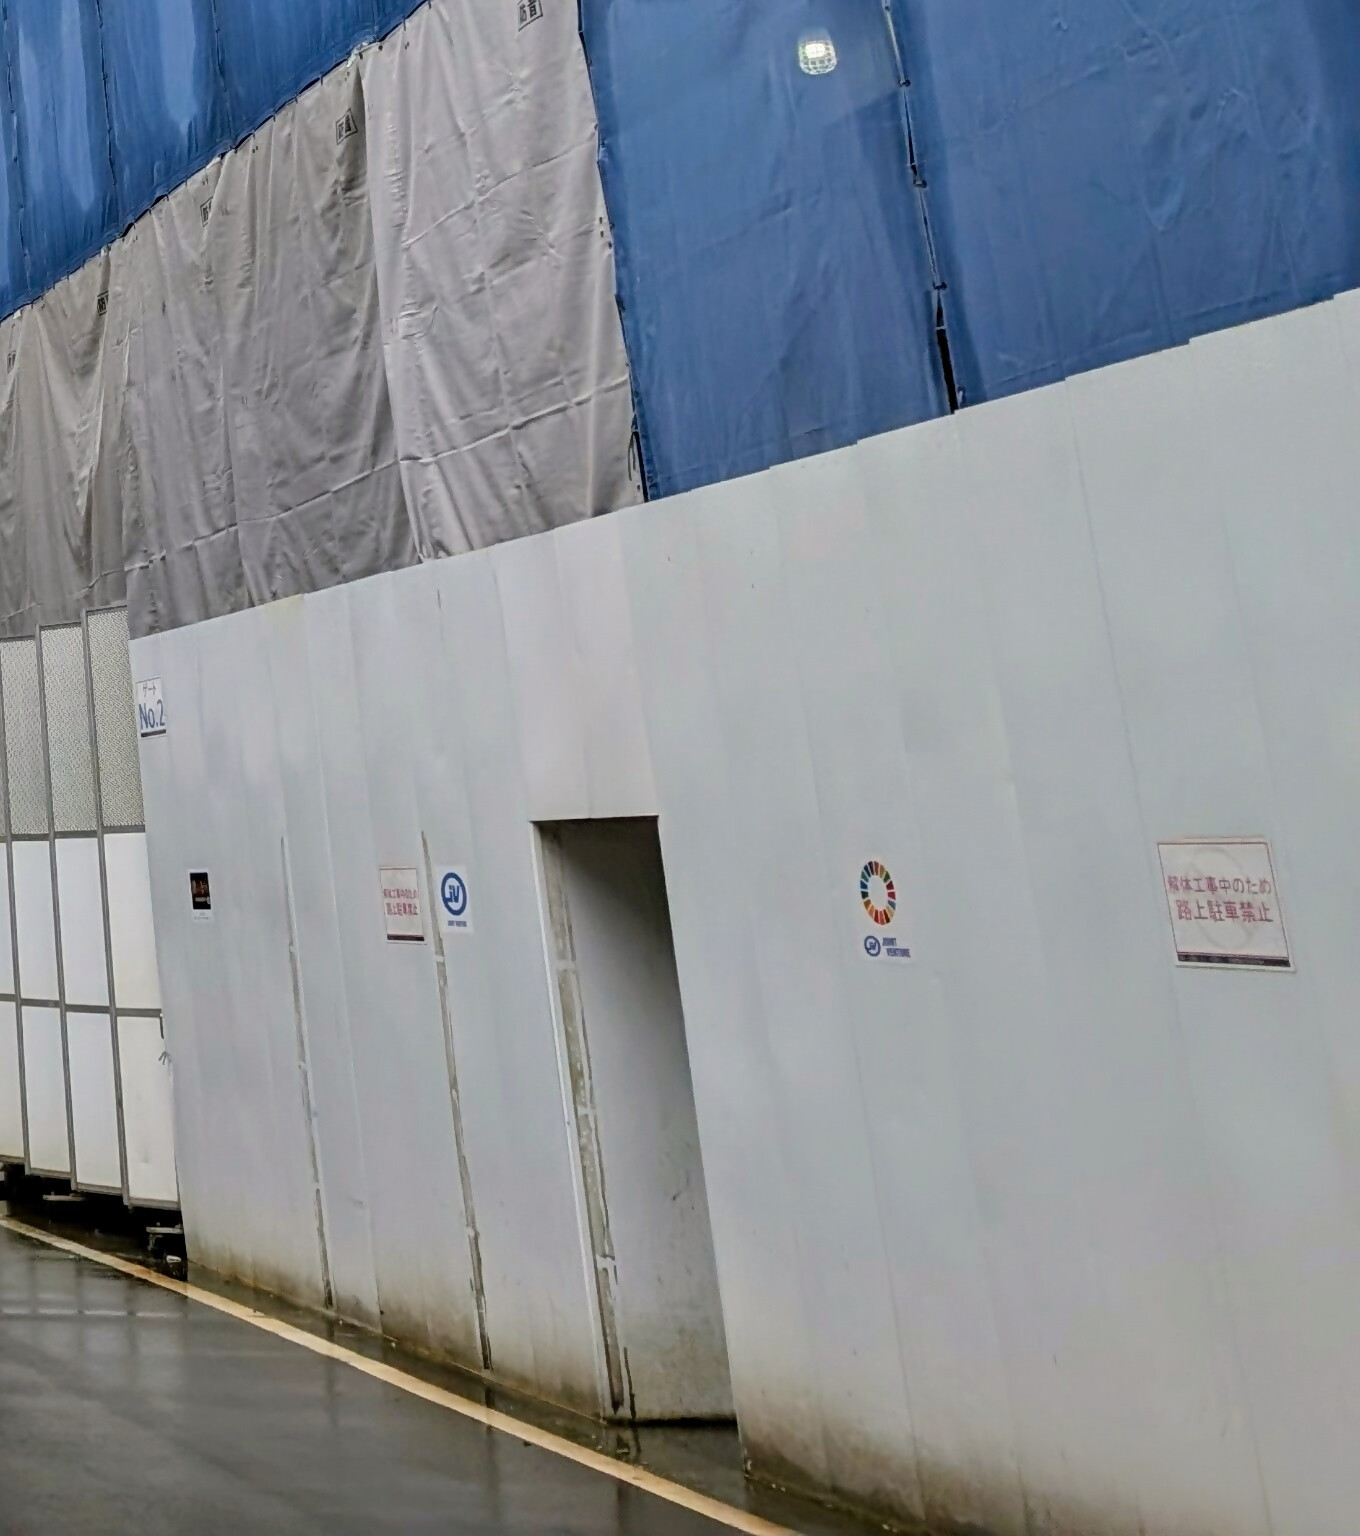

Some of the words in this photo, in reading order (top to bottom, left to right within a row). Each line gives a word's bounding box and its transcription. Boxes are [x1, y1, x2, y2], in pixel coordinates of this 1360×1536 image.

[142, 681, 156, 698] ゲート
[138, 699, 166, 731] No.2
[1167, 875, 1272, 895] 解体工事中のため
[1175, 899, 1274, 923] 路上駐車禁止
